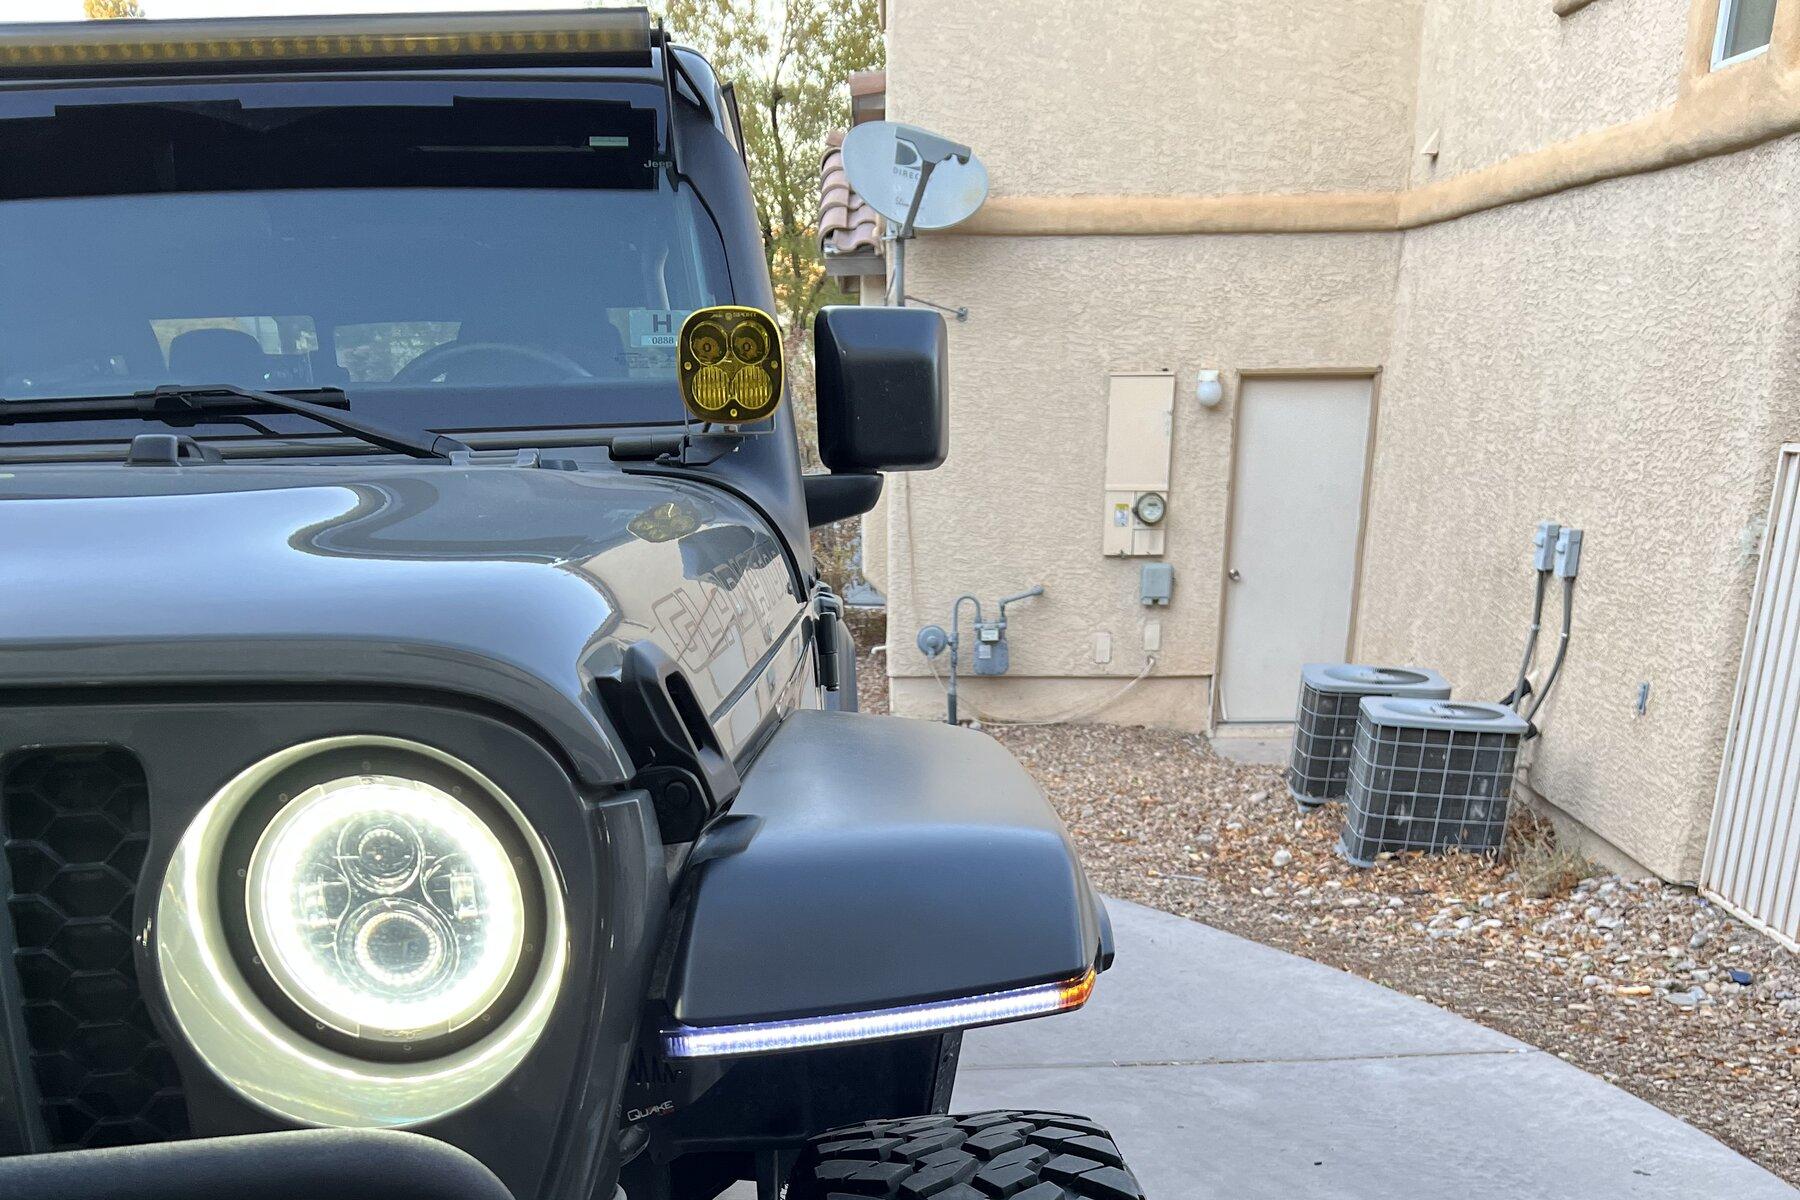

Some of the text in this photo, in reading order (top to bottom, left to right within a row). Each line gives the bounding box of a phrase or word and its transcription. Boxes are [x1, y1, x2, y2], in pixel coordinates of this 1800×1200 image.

[643, 160, 673, 168] Jeep
[652, 314, 672, 333] H
[627, 1100, 675, 1121] QUAKE
